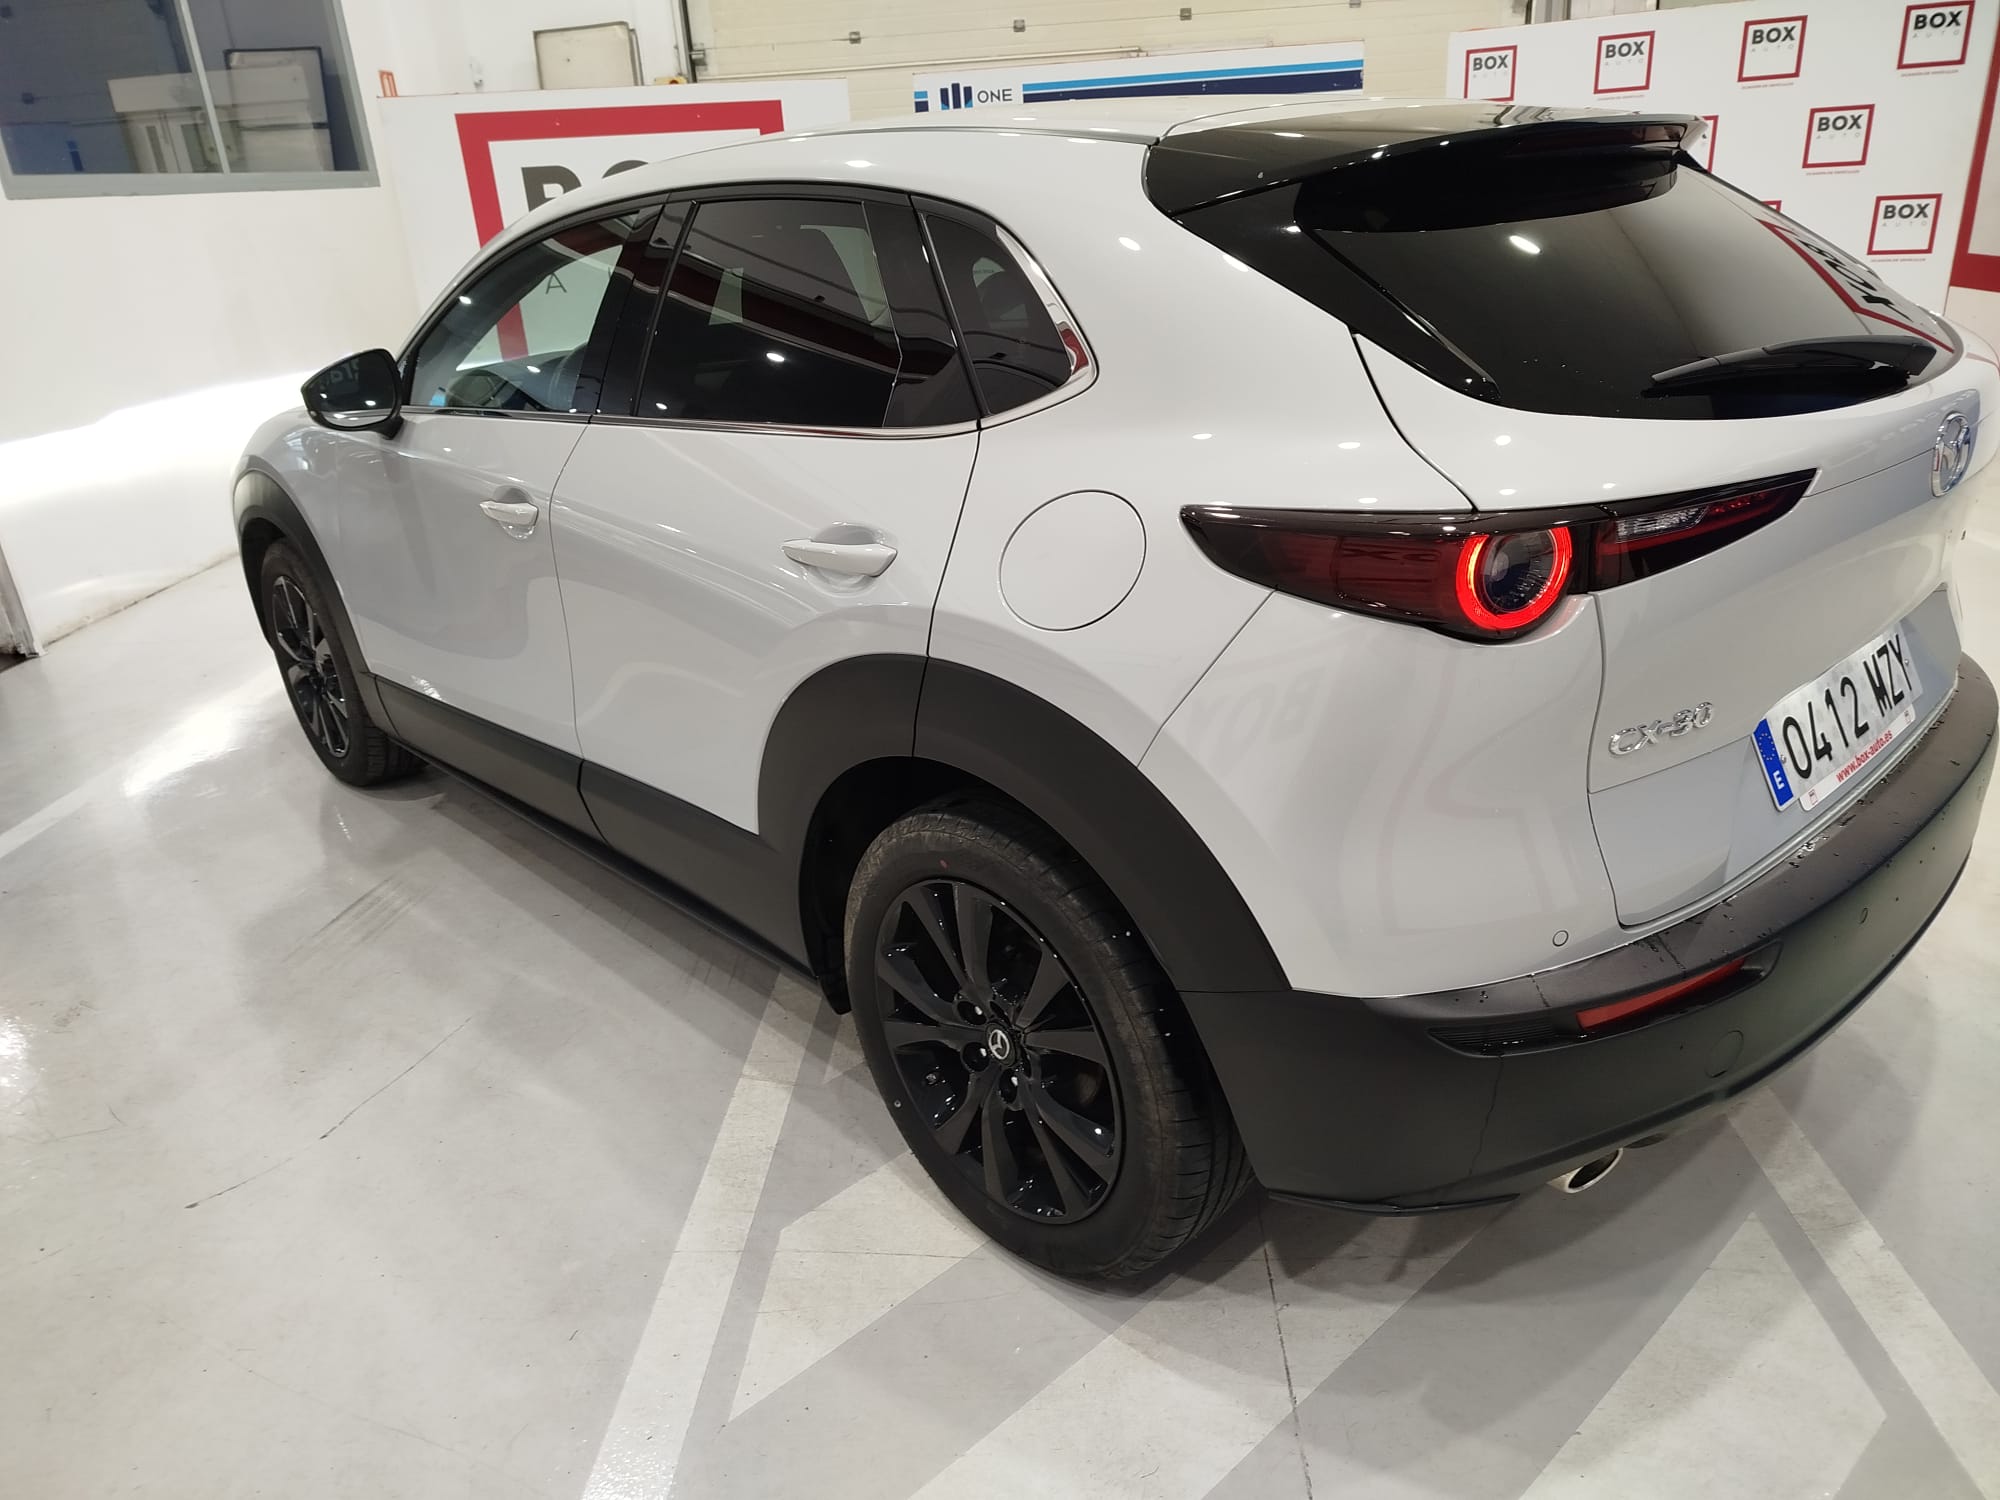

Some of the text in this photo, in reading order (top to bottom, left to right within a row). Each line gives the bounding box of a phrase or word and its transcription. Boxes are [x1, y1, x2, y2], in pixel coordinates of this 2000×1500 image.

[1914, 10, 1962, 30] BOX
[1752, 26, 1796, 44] BOX
[1605, 41, 1645, 58] BOX
[1473, 55, 1508, 71] BOX
[977, 89, 1012, 103] ONE
[1817, 114, 1863, 131] BOX
[1883, 203, 1930, 219] BOX
[1783, 634, 1912, 779] 0412 MZY
[1609, 702, 1713, 755] CX-30
[1836, 730, 1892, 782] www.box-auto.es
[1773, 770, 1785, 789] E
